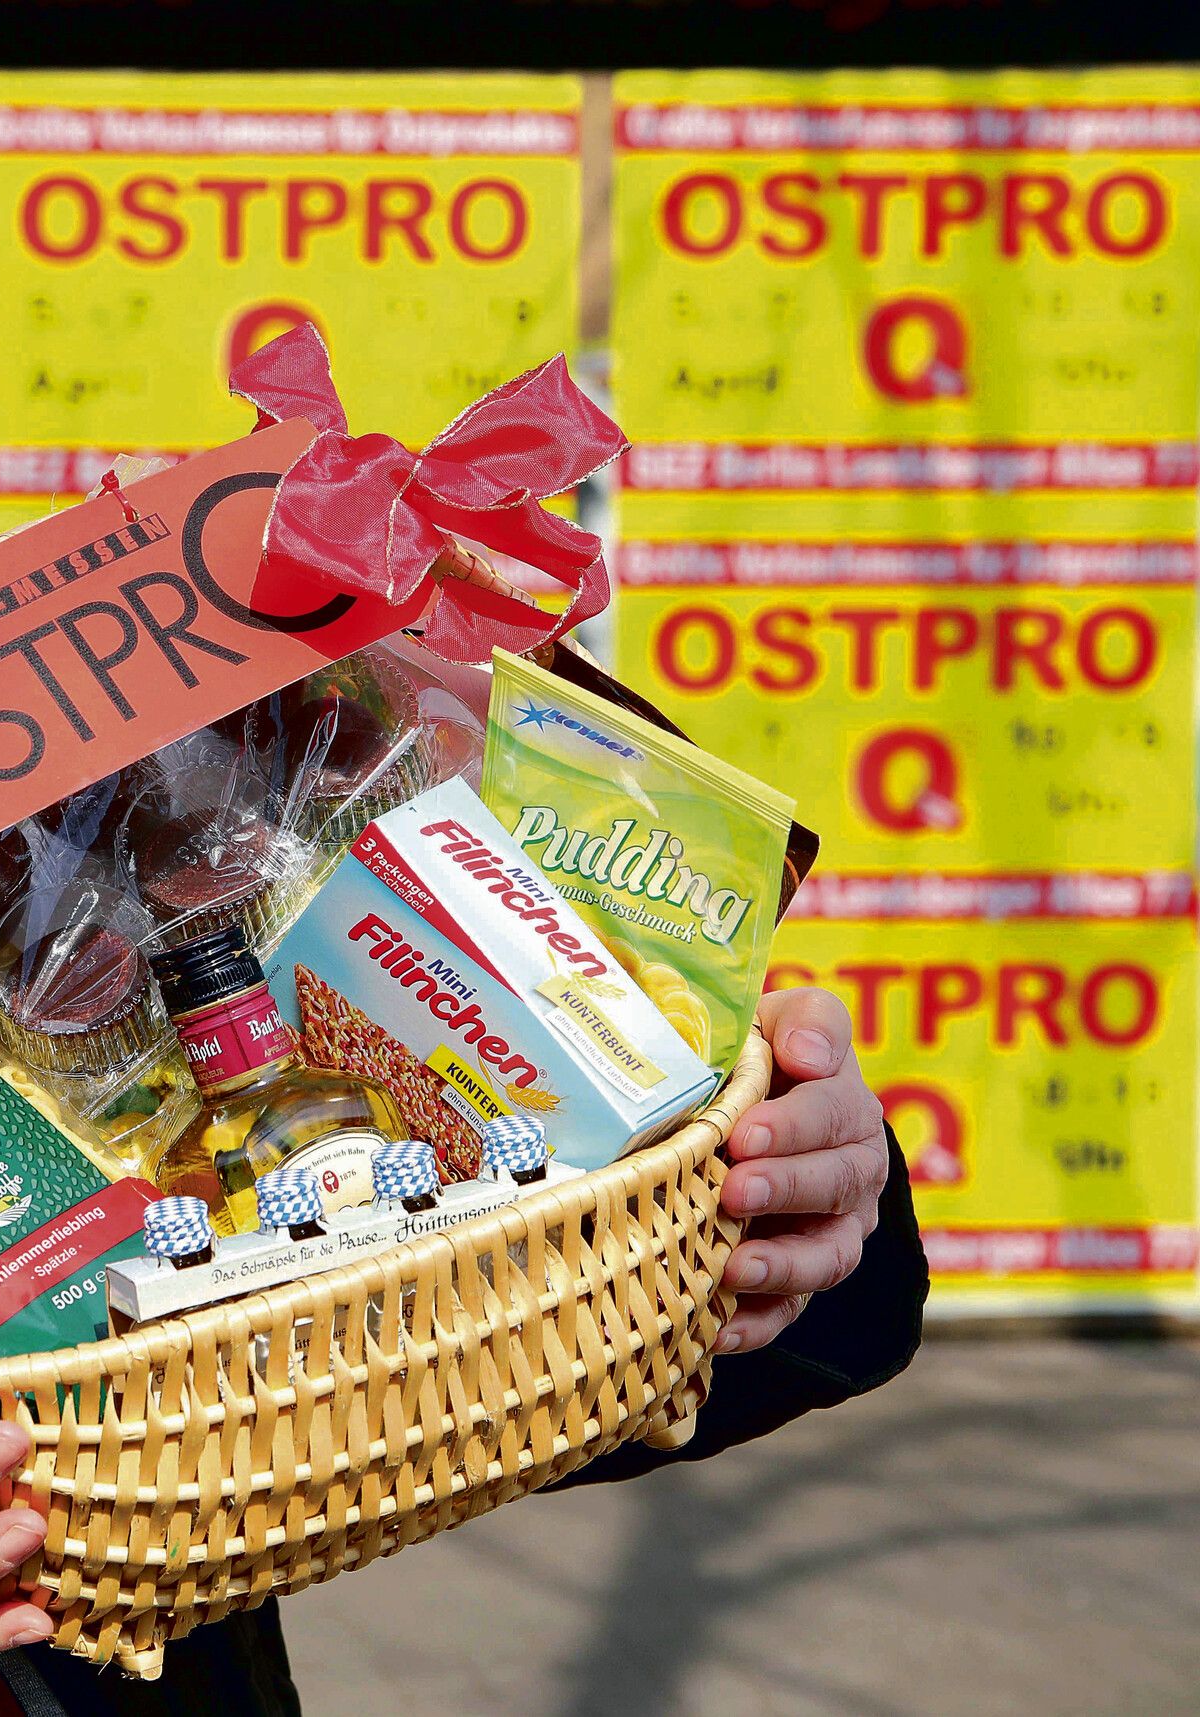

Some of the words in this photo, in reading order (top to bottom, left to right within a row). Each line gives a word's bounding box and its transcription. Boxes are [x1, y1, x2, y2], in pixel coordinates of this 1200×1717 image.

[22, 176, 528, 261] OSTPRO
[661, 172, 1168, 259] OSTPRO
[655, 606, 1160, 693] OSTPRO
[360, 837, 377, 852] 3
[372, 851, 434, 906] Packungen
[380, 872, 426, 913] Scheiben
[420, 818, 608, 978] Filinchen
[506, 867, 554, 903] Mini
[511, 806, 753, 946] Pudding
[552, 882, 698, 944] anas-Geschmack
[347, 912, 539, 1089] Filinchen
[427, 958, 478, 1001] Mini
[763, 962, 1161, 1048] TPRO
[246, 1013, 274, 1041] Bad
[559, 990, 645, 1072] KUNTERBUNT
[445, 1062, 506, 1118] KUNTER
[447, 1090, 467, 1111] ohne
[312, 1154, 332, 1167] bricht
[347, 1148, 366, 1156] Bahn
[340, 1169, 357, 1181] 1876
[394, 1200, 513, 1243] Hüttensau
[211, 1268, 237, 1284] Das
[300, 1246, 314, 1264] für
[320, 1243, 334, 1257] die
[51, 1284, 83, 1310] 500
[82, 1278, 98, 1295] g
